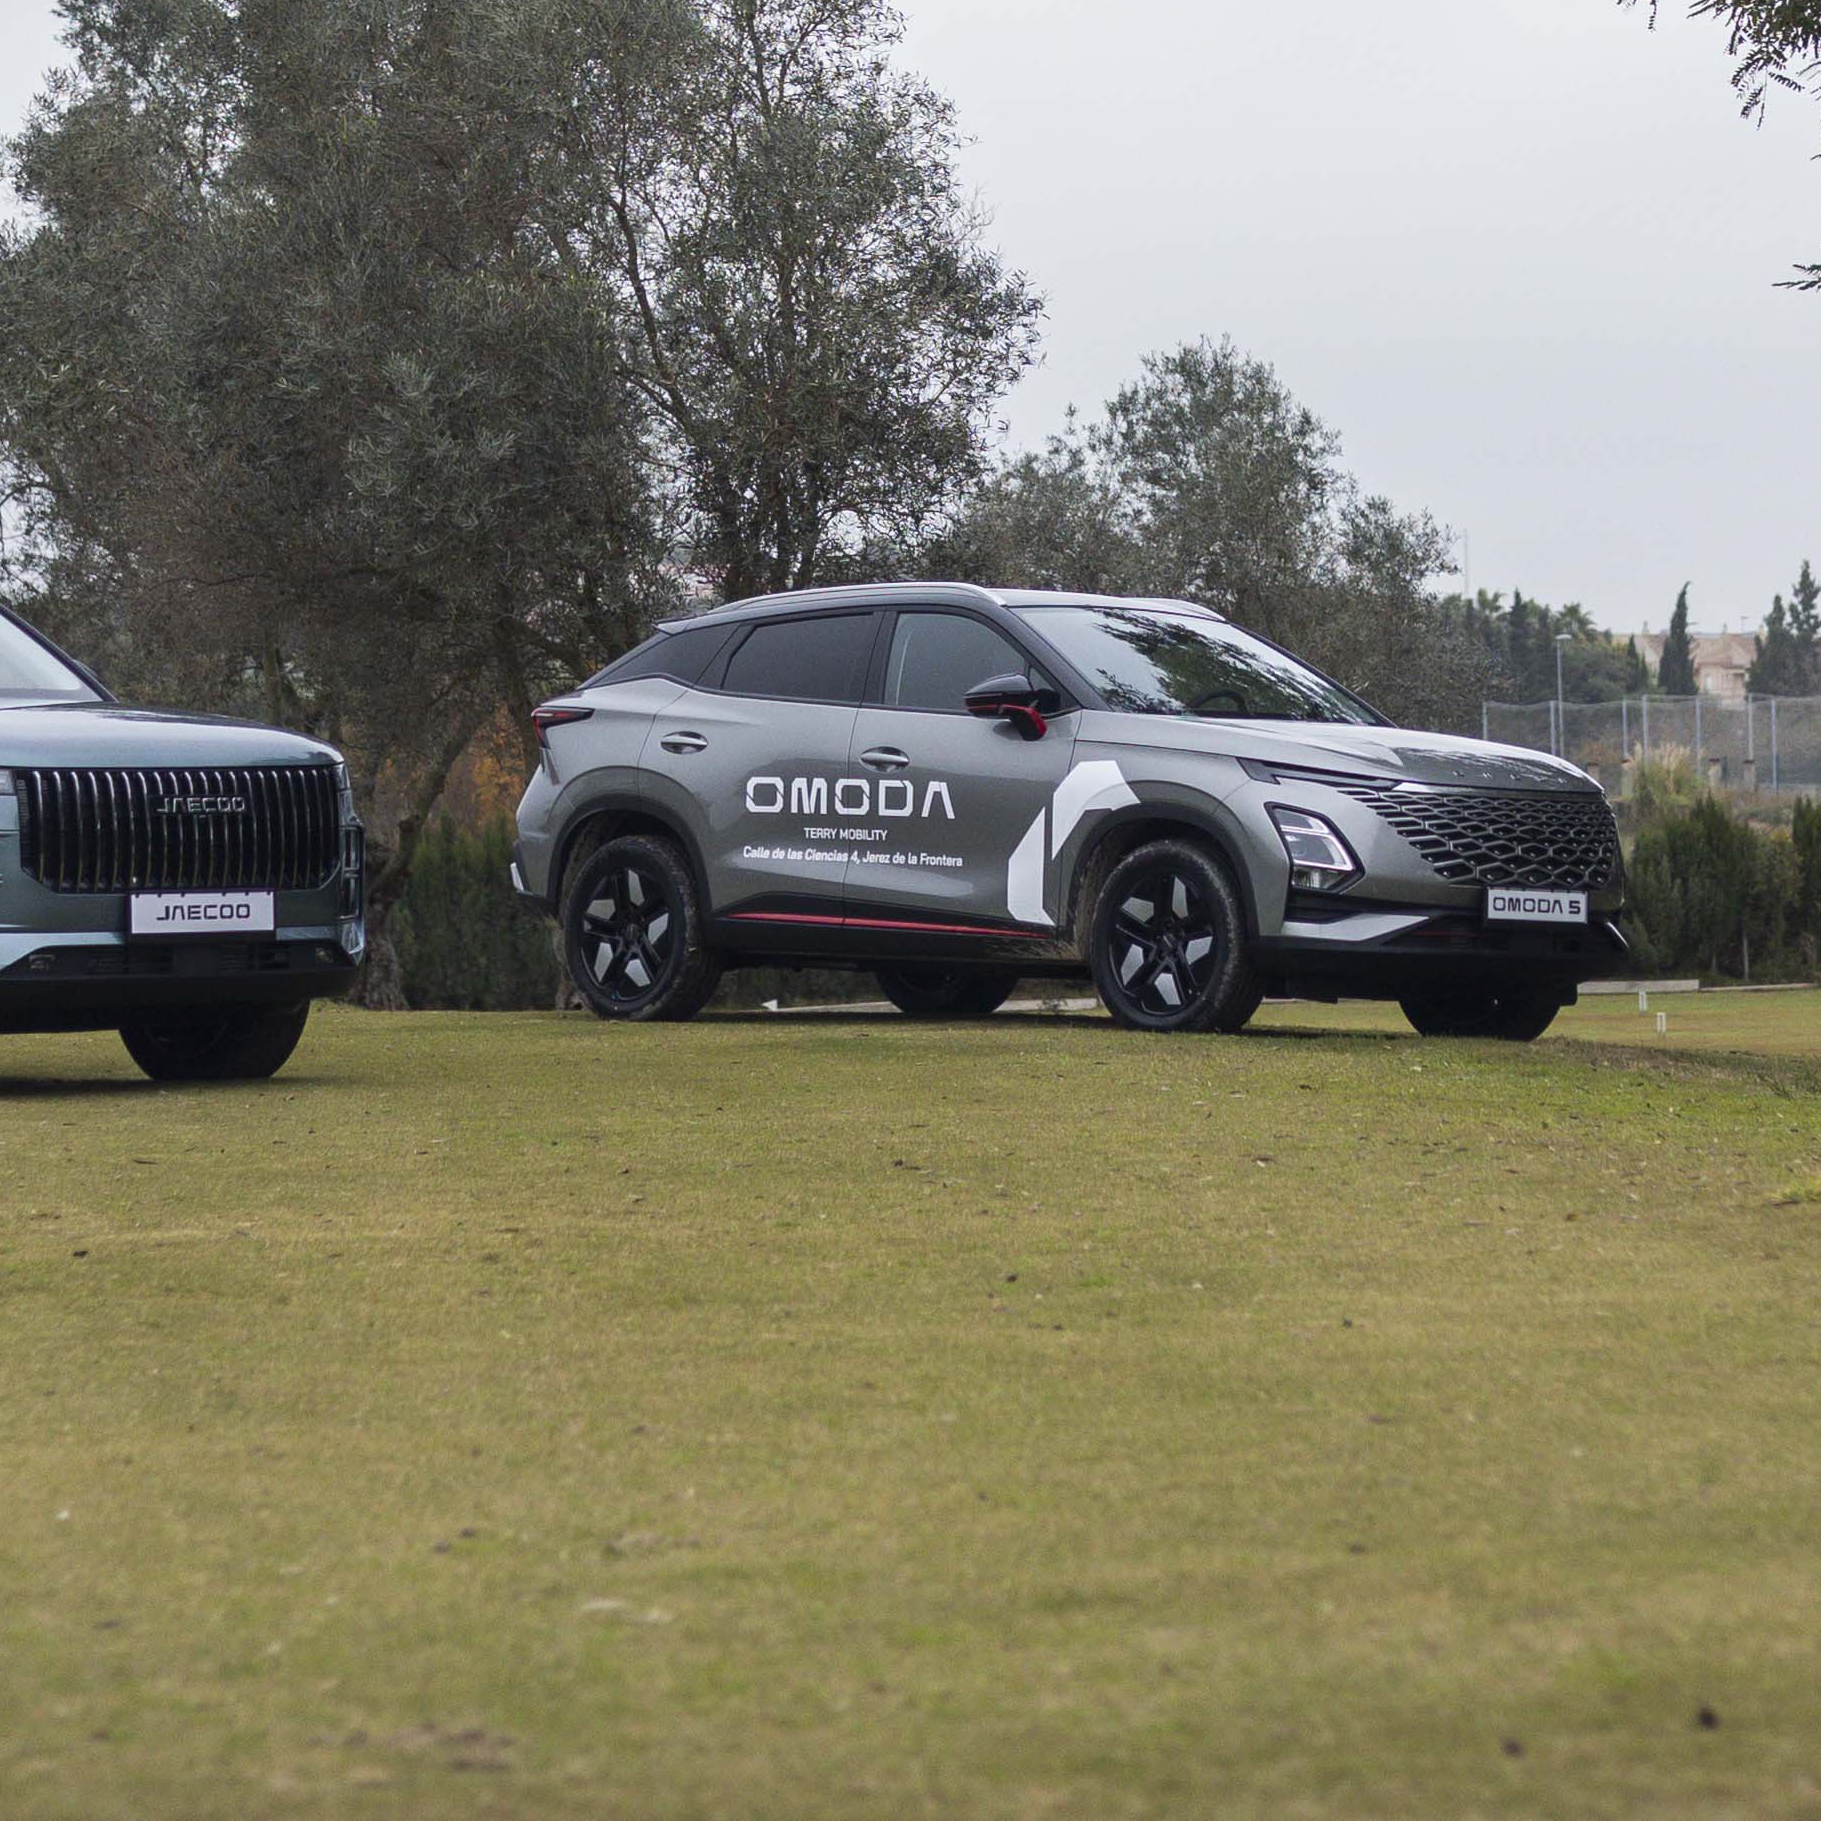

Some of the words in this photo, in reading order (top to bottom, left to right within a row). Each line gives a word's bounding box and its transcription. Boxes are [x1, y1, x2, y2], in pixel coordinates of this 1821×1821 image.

[156, 797, 246, 813] JAECOO
[745, 776, 956, 820] OMODA
[803, 827, 837, 839] TERRY
[839, 828, 888, 841] MOBILITY
[743, 845, 770, 859] Calle
[772, 848, 785, 859] de
[787, 848, 803, 860] las
[805, 848, 849, 862] Ciencias
[850, 850, 860, 865] 4,
[862, 851, 891, 864] Jerez
[892, 851, 906, 864] de
[908, 852, 917, 865] la
[920, 852, 963, 867] Frontera
[156, 904, 251, 921] JAECOO
[1493, 896, 1563, 914] OMODA
[1568, 900, 1581, 914] 5
